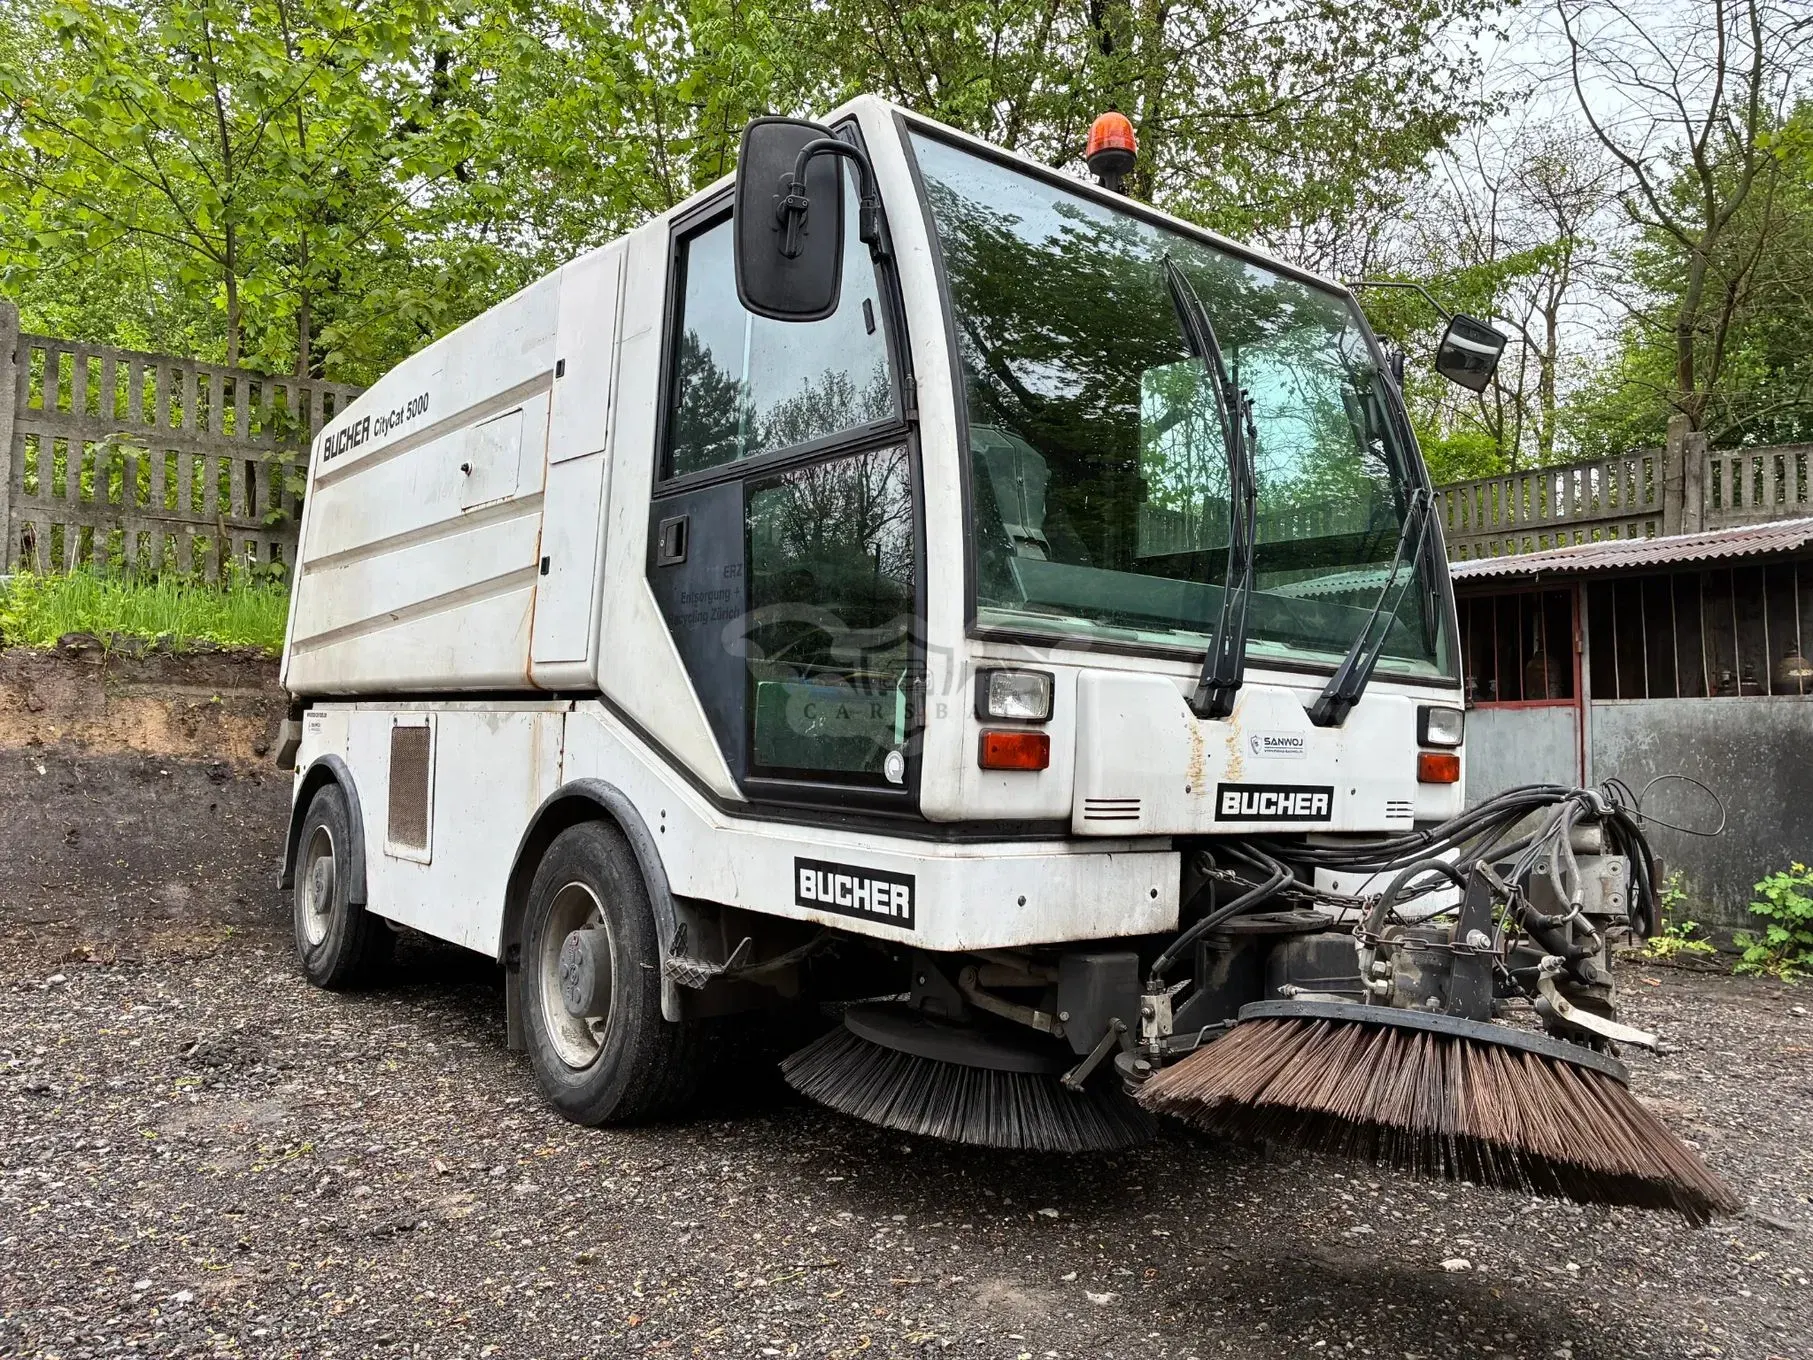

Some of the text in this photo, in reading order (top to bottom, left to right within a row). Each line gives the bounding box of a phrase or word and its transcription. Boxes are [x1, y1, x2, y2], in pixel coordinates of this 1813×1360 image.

[323, 391, 429, 462] BUCHER CityCat 5000
[723, 563, 743, 579] ERZ
[681, 588, 731, 605] Entsorgung
[1263, 737, 1304, 747] SANWOJ
[1221, 791, 1329, 816] BUCHER
[799, 867, 910, 919] BUCHER
